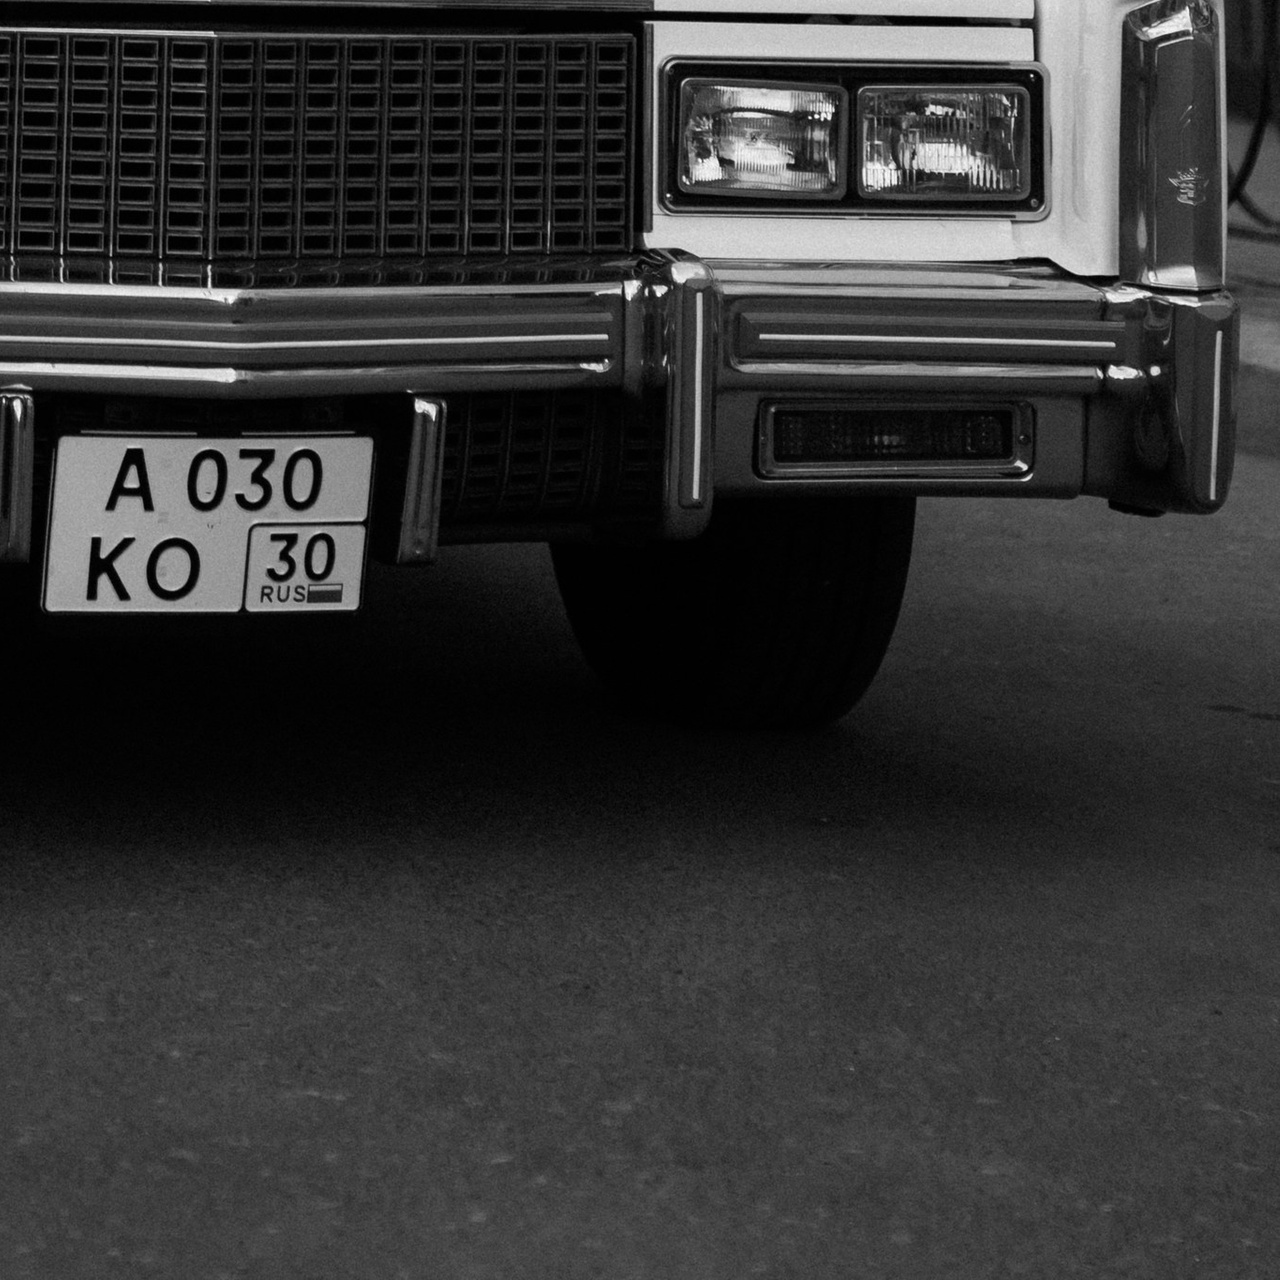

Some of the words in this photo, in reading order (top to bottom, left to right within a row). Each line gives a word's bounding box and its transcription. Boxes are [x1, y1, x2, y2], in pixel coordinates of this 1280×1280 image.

[105, 448, 155, 512] A
[187, 448, 324, 512] 030
[86, 536, 201, 601] KO
[266, 533, 336, 583] 30
[260, 585, 306, 603] RUS
